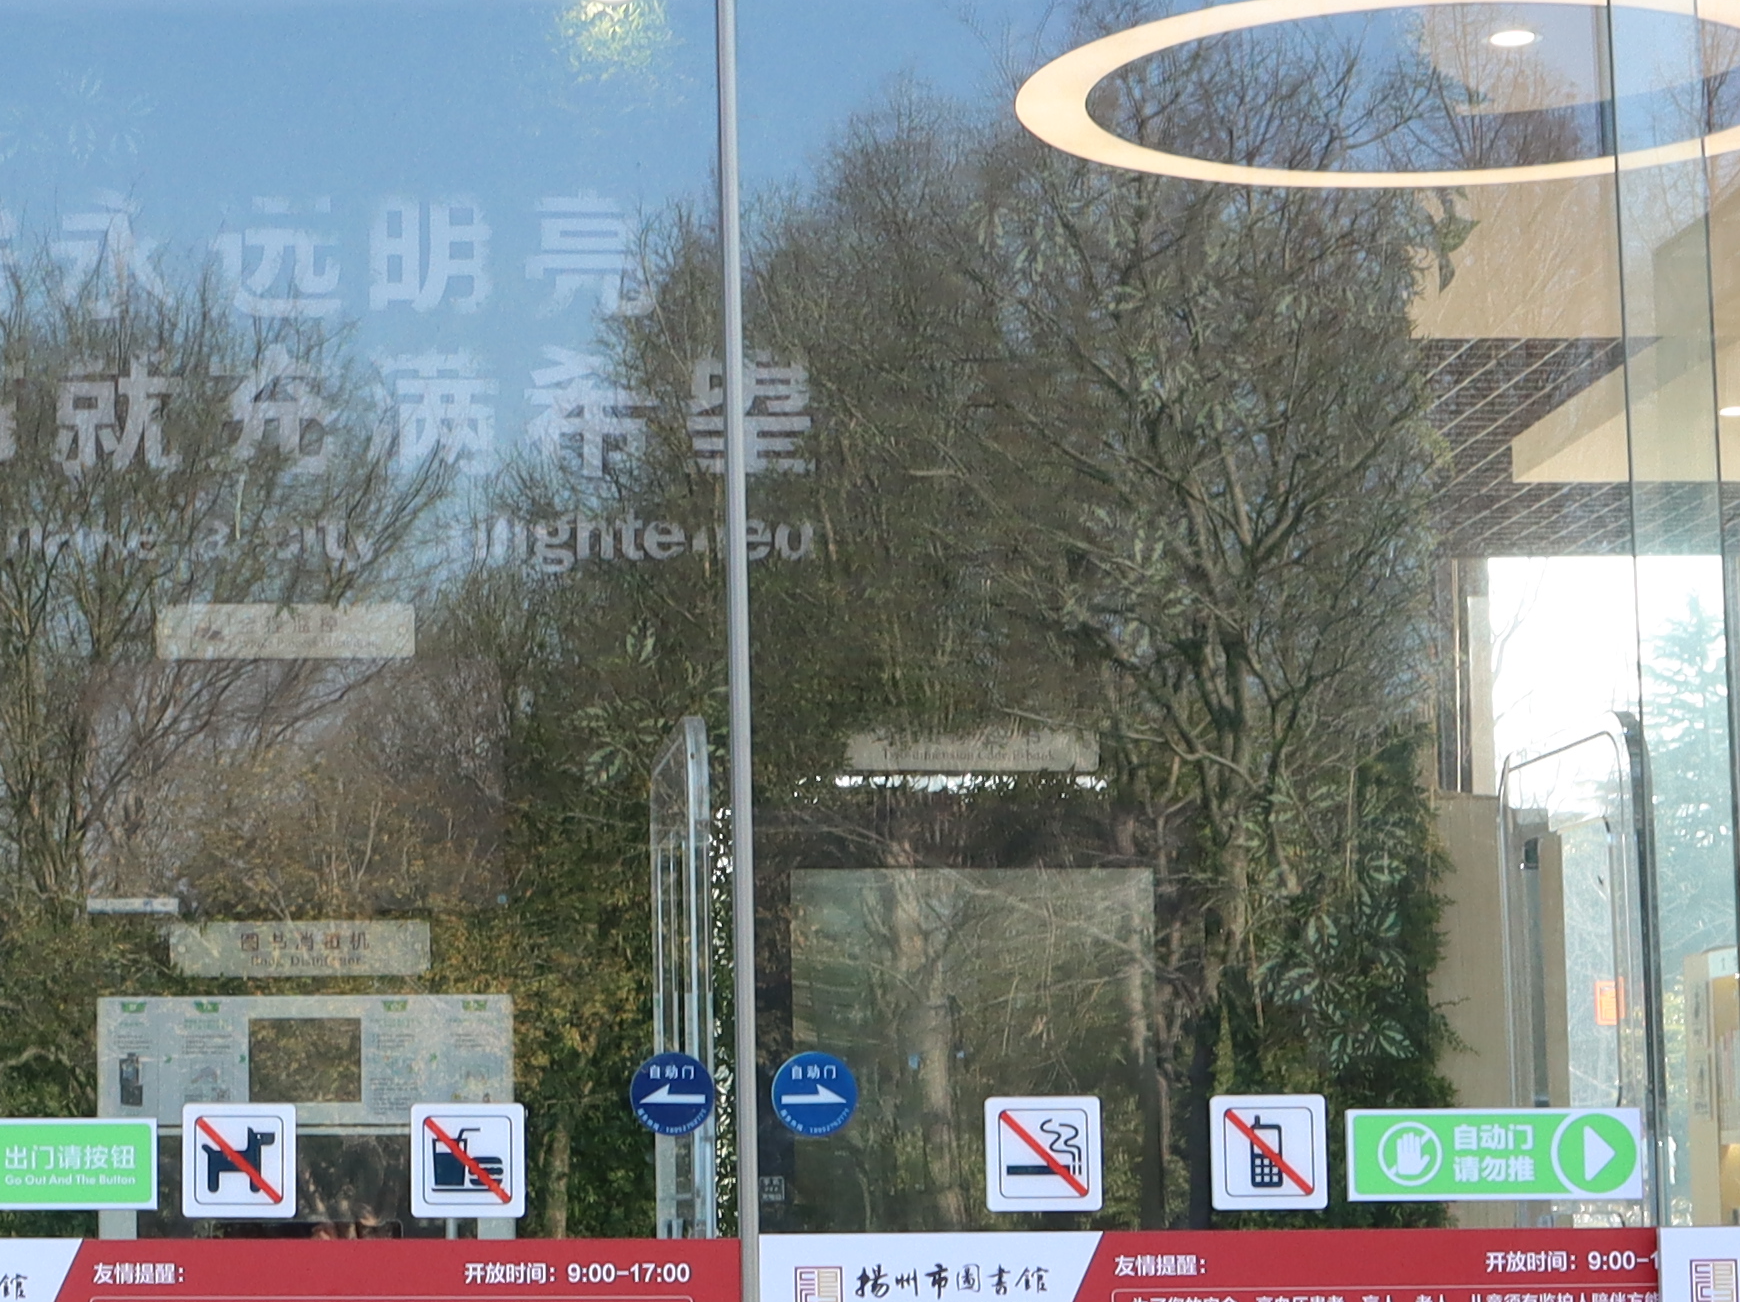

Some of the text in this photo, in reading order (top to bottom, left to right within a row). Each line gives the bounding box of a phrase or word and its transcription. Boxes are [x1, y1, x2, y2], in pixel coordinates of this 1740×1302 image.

[649, 1064, 695, 1080] 自动门
[791, 1064, 837, 1080] 自动门
[1452, 1124, 1533, 1150] 自动门
[4, 1144, 136, 1170] 出门请按钮
[1452, 1155, 1535, 1183] 请勿推
[5, 1174, 136, 1185] Go Out And The Button
[92, 1261, 185, 1286] 友情提醒：
[1113, 1253, 1206, 1276] 友情提醒：
